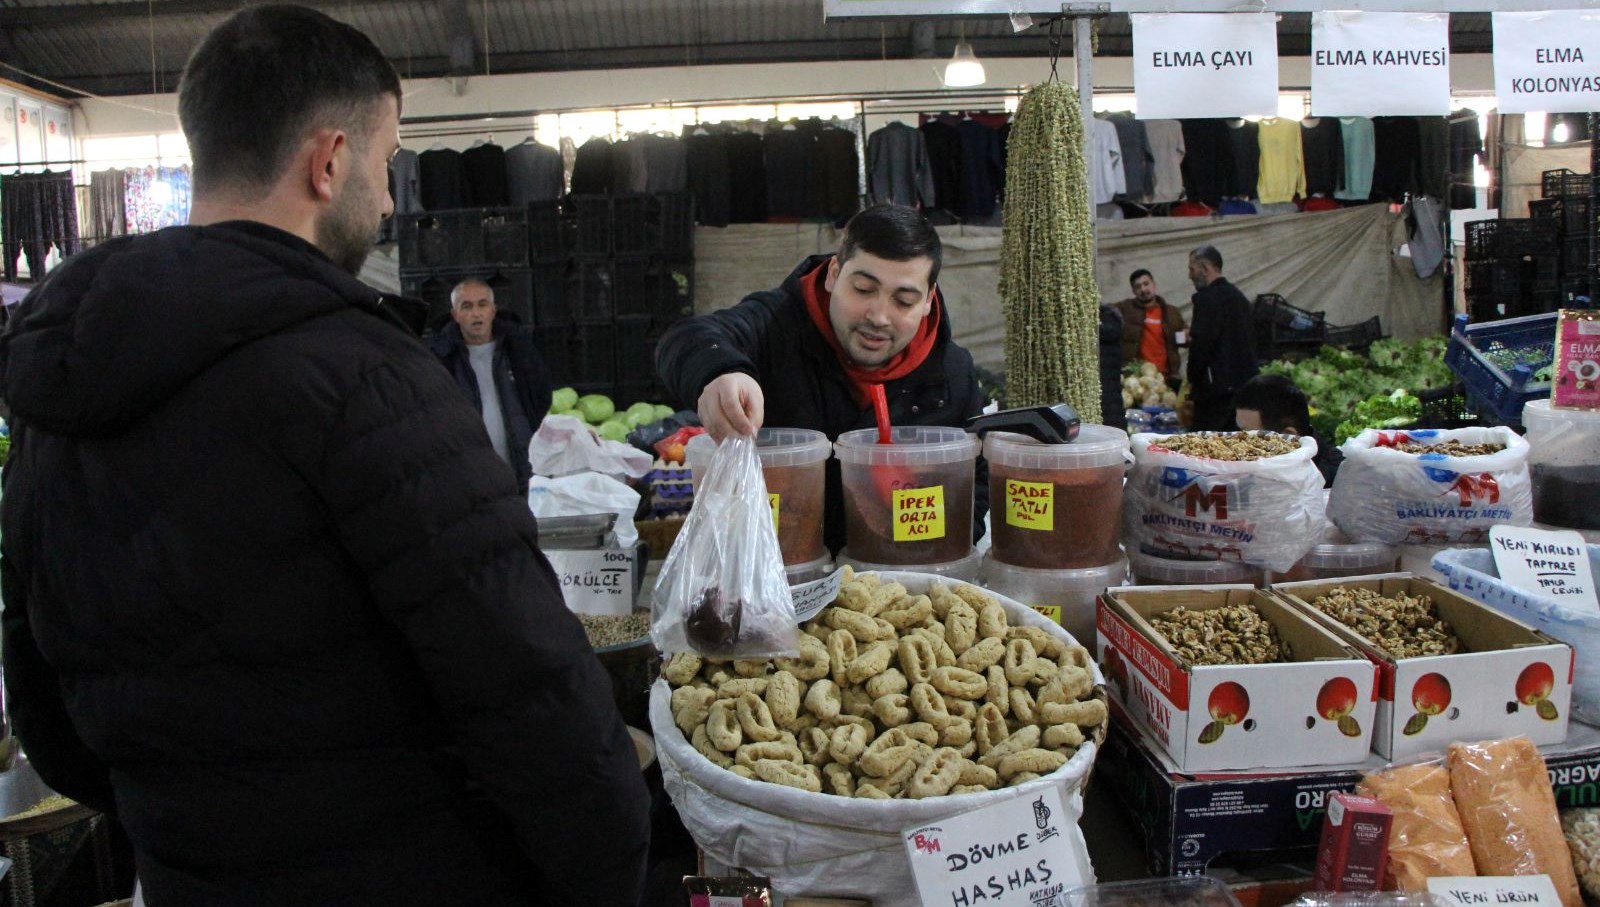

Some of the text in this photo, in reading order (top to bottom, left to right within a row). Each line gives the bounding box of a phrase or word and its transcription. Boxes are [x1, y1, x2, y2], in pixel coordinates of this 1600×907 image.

[1152, 50, 1253, 71] ELMA ÇAYI
[1315, 47, 1447, 67] ELMA KAHVESİ
[1536, 47, 1584, 63] ELMA
[1512, 76, 1600, 93] KOLONYAS
[1008, 483, 1050, 497] SADE
[900, 494, 935, 509] İPEK
[1012, 498, 1048, 514] TATLI
[900, 511, 936, 523] ORTA
[1495, 537, 1580, 555] YENİ KIRILDI
[560, 571, 621, 587] ÖRÜLCE
[1031, 606, 1055, 615] TLI
[946, 833, 1029, 872] DÖVME
[1450, 889, 1539, 904] YENİ ÜRÜN
